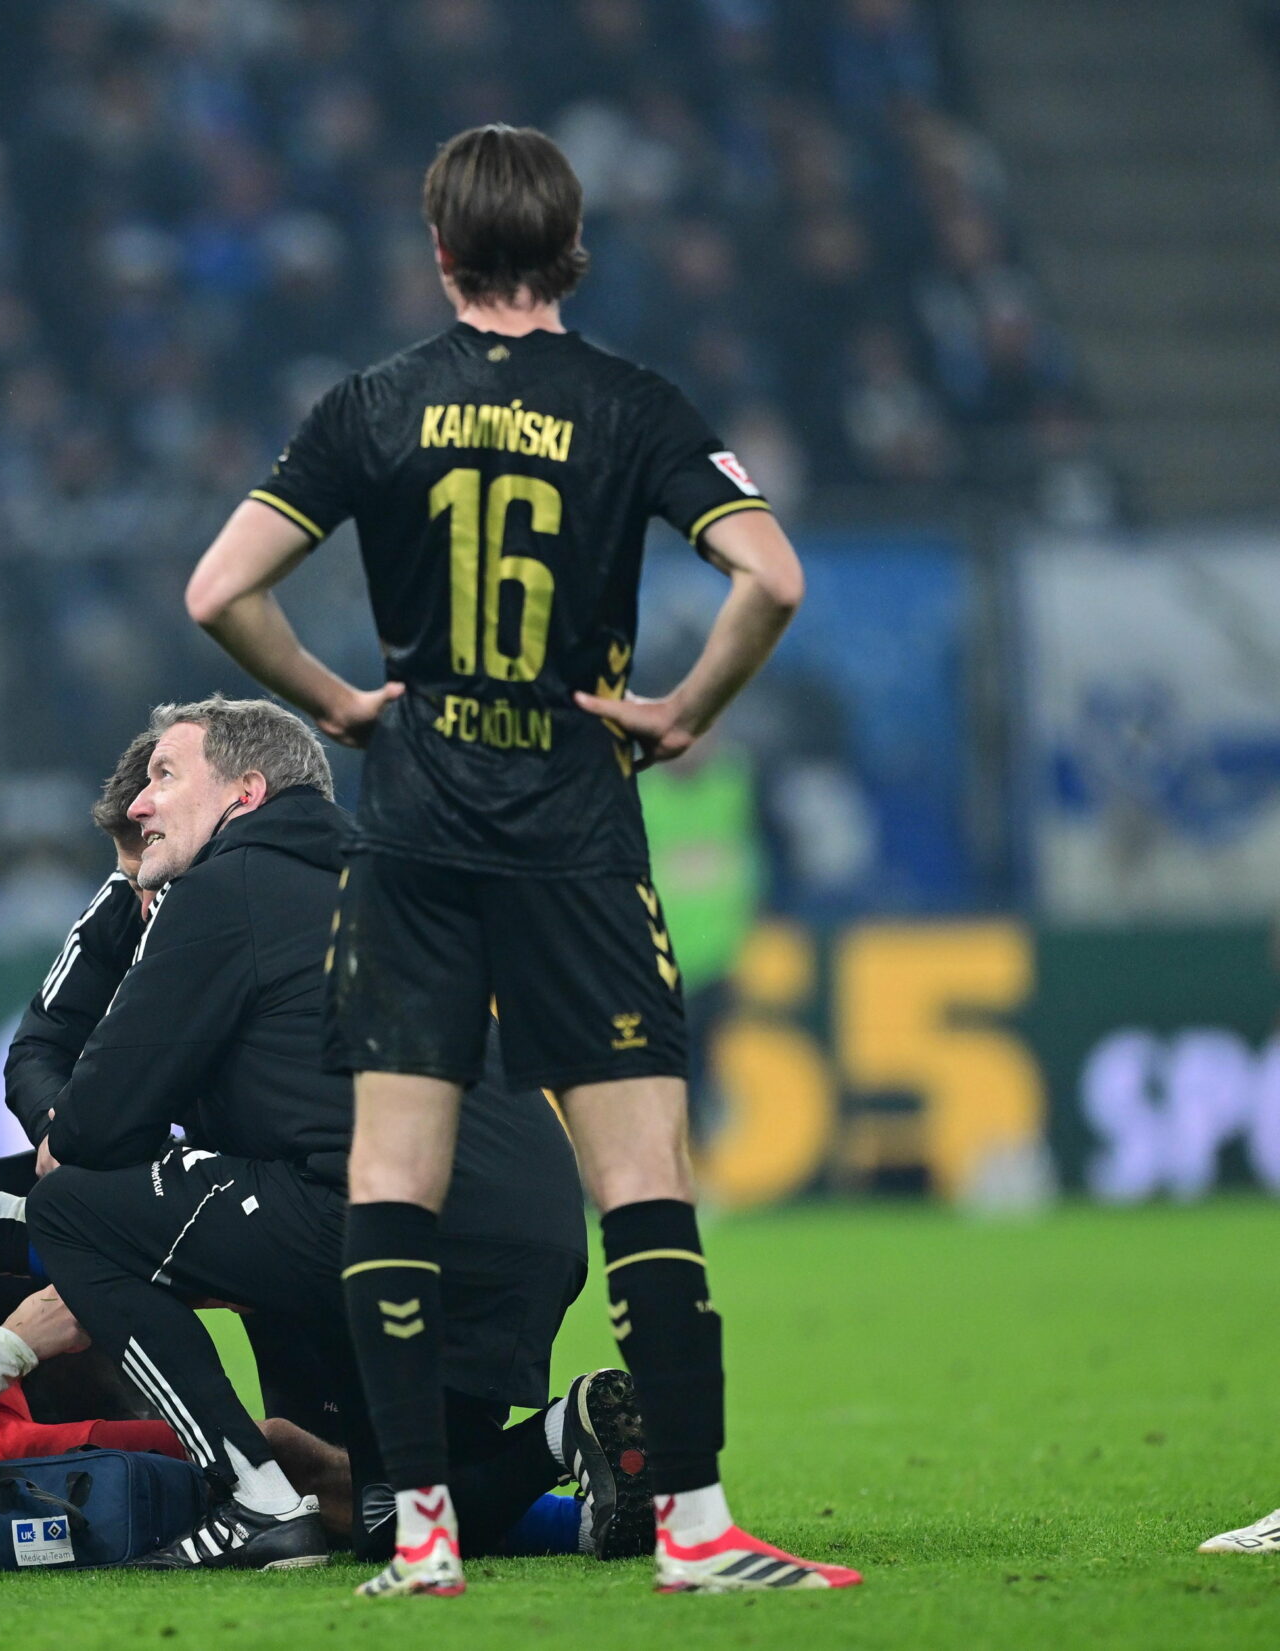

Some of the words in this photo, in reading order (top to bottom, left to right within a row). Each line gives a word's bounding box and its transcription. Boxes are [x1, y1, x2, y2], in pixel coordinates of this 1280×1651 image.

[421, 399, 574, 463] KAMIŃSKI
[429, 468, 562, 682] 16
[483, 699, 551, 752] KÖLN
